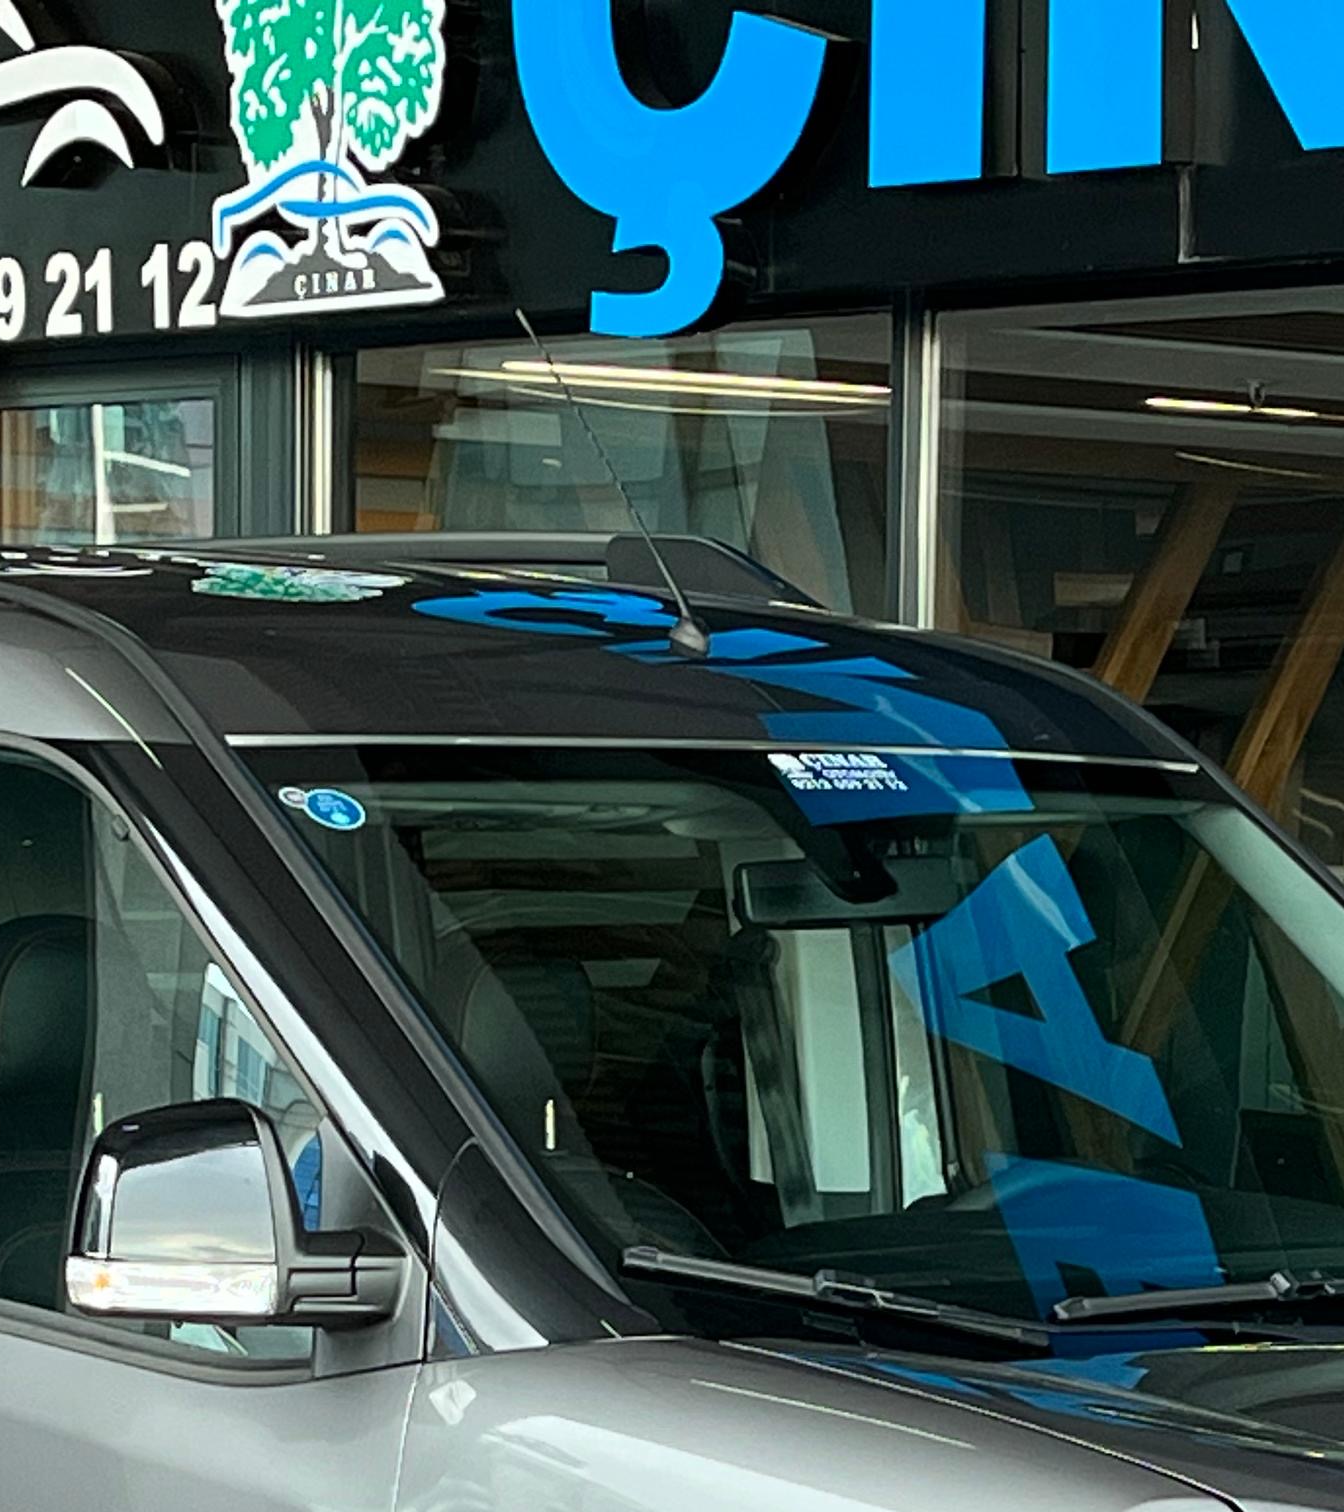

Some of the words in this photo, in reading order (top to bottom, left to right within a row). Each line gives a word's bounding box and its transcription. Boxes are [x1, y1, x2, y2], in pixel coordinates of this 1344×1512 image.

[45, 248, 113, 338] 21
[141, 240, 217, 329] 12
[294, 269, 376, 300] ÇINAR
